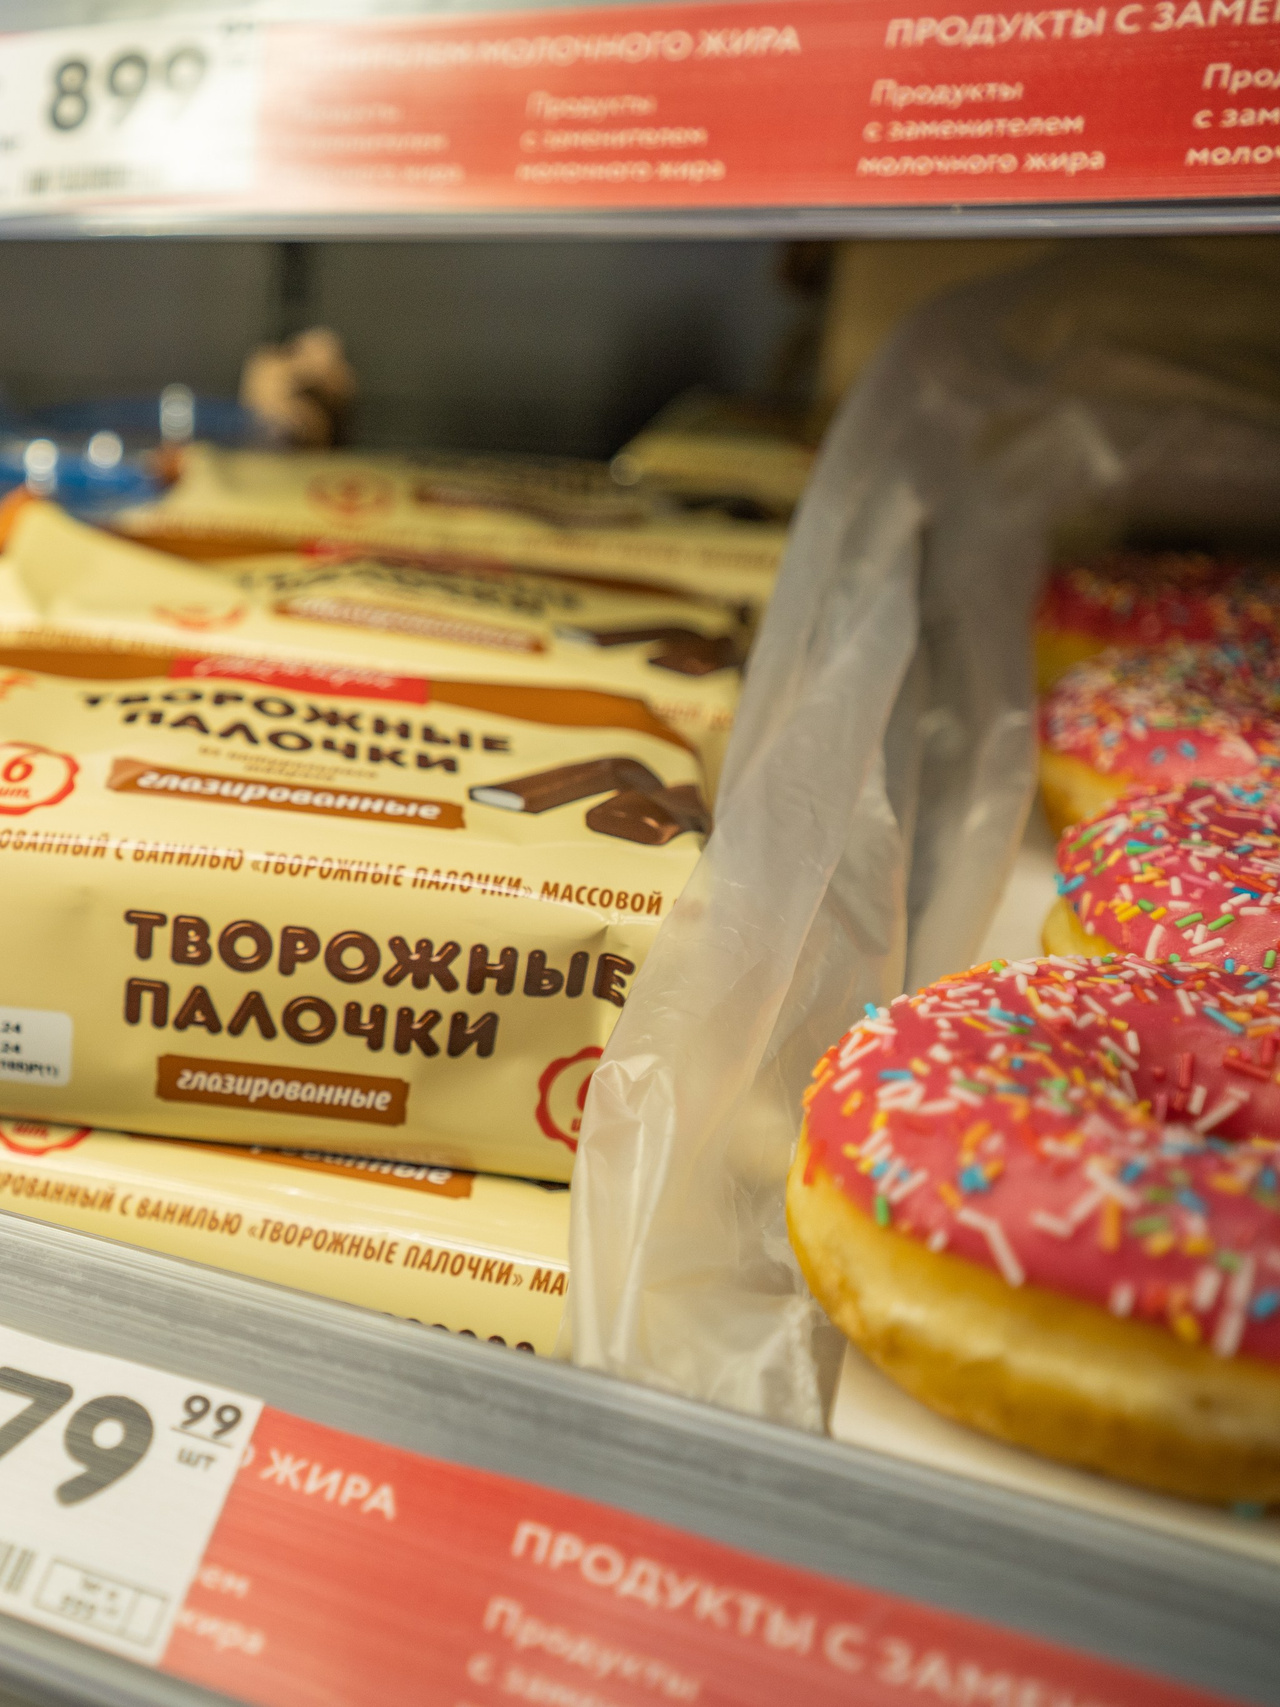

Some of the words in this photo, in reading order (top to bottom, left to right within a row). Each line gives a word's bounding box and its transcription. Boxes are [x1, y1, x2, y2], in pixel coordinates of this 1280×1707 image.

[885, 7, 1105, 49] ПРОДУКТЫ
[1115, 3, 1144, 34] С
[49, 45, 209, 131] 899
[869, 79, 1024, 110] Продукты
[863, 121, 883, 142] с
[887, 114, 1084, 142] заменителем
[1192, 109, 1213, 129] с
[856, 152, 1018, 177] молочного
[1023, 150, 1105, 177] жира
[123, 710, 460, 774] ПАЛОЧКИ
[1, 752, 34, 783] 6
[136, 770, 443, 821] глазированные
[132, 846, 244, 872] ВАНИЛЬЮ
[252, 848, 406, 888] «ТВОРОЖНЫЕ
[412, 866, 532, 900] ПАЛОЧКИ»
[540, 882, 663, 916] МАССОВОЙ
[124, 909, 636, 1008] ТВОРОЖНЫЕ
[124, 977, 500, 1059] ПАЛОЧКИ
[176, 1067, 393, 1113] глазированные
[136, 1195, 242, 1236] ВАНИЛЬЮ
[248, 1217, 399, 1265] «ТВОРОЖНЫЕ
[403, 1244, 524, 1288] ПАЛОЧКИ»
[180, 1394, 243, 1440] 99
[177, 1447, 217, 1473] шт
[259, 1446, 397, 1521] ЖИРА
[511, 1519, 816, 1656] ПРОДУКТЫ
[825, 1623, 868, 1671] С
